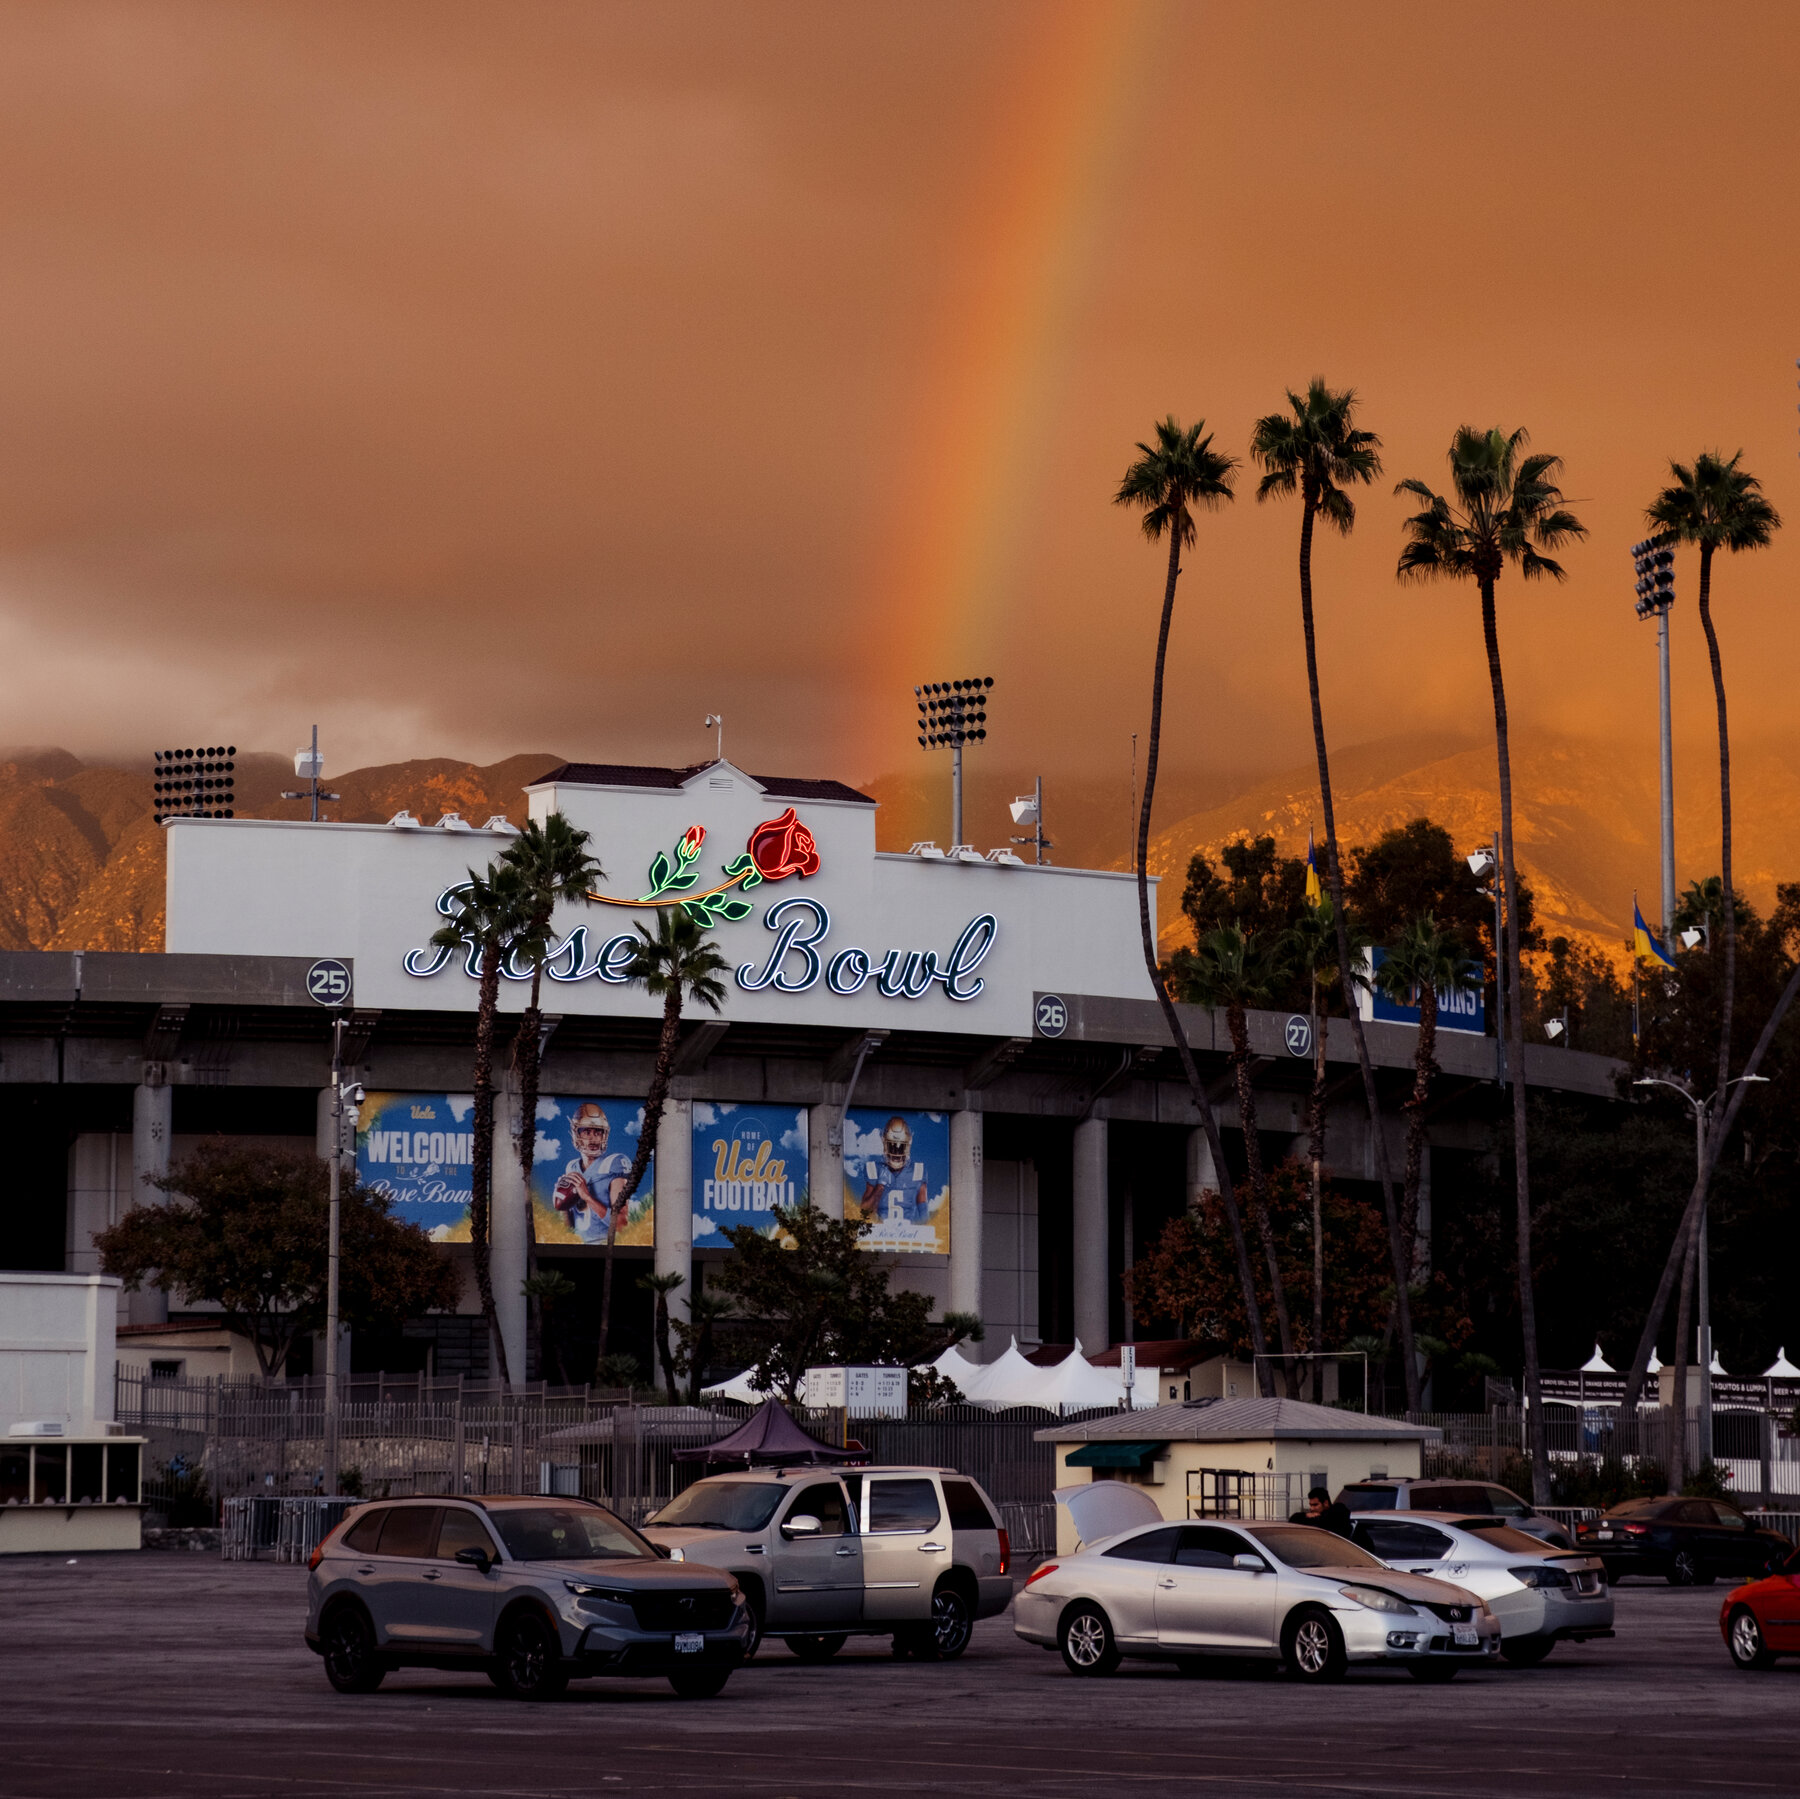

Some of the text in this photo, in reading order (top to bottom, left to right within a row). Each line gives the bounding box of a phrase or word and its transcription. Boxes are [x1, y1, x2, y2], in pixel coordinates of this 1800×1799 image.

[734, 896, 999, 1002] Bowl
[311, 969, 346, 995] 25
[1038, 1004, 1064, 1028] 26
[1288, 1025, 1309, 1048] 27
[741, 1131, 761, 1140] HOME
[746, 1143, 755, 1151] OF
[712, 1139, 788, 1184] Ucla
